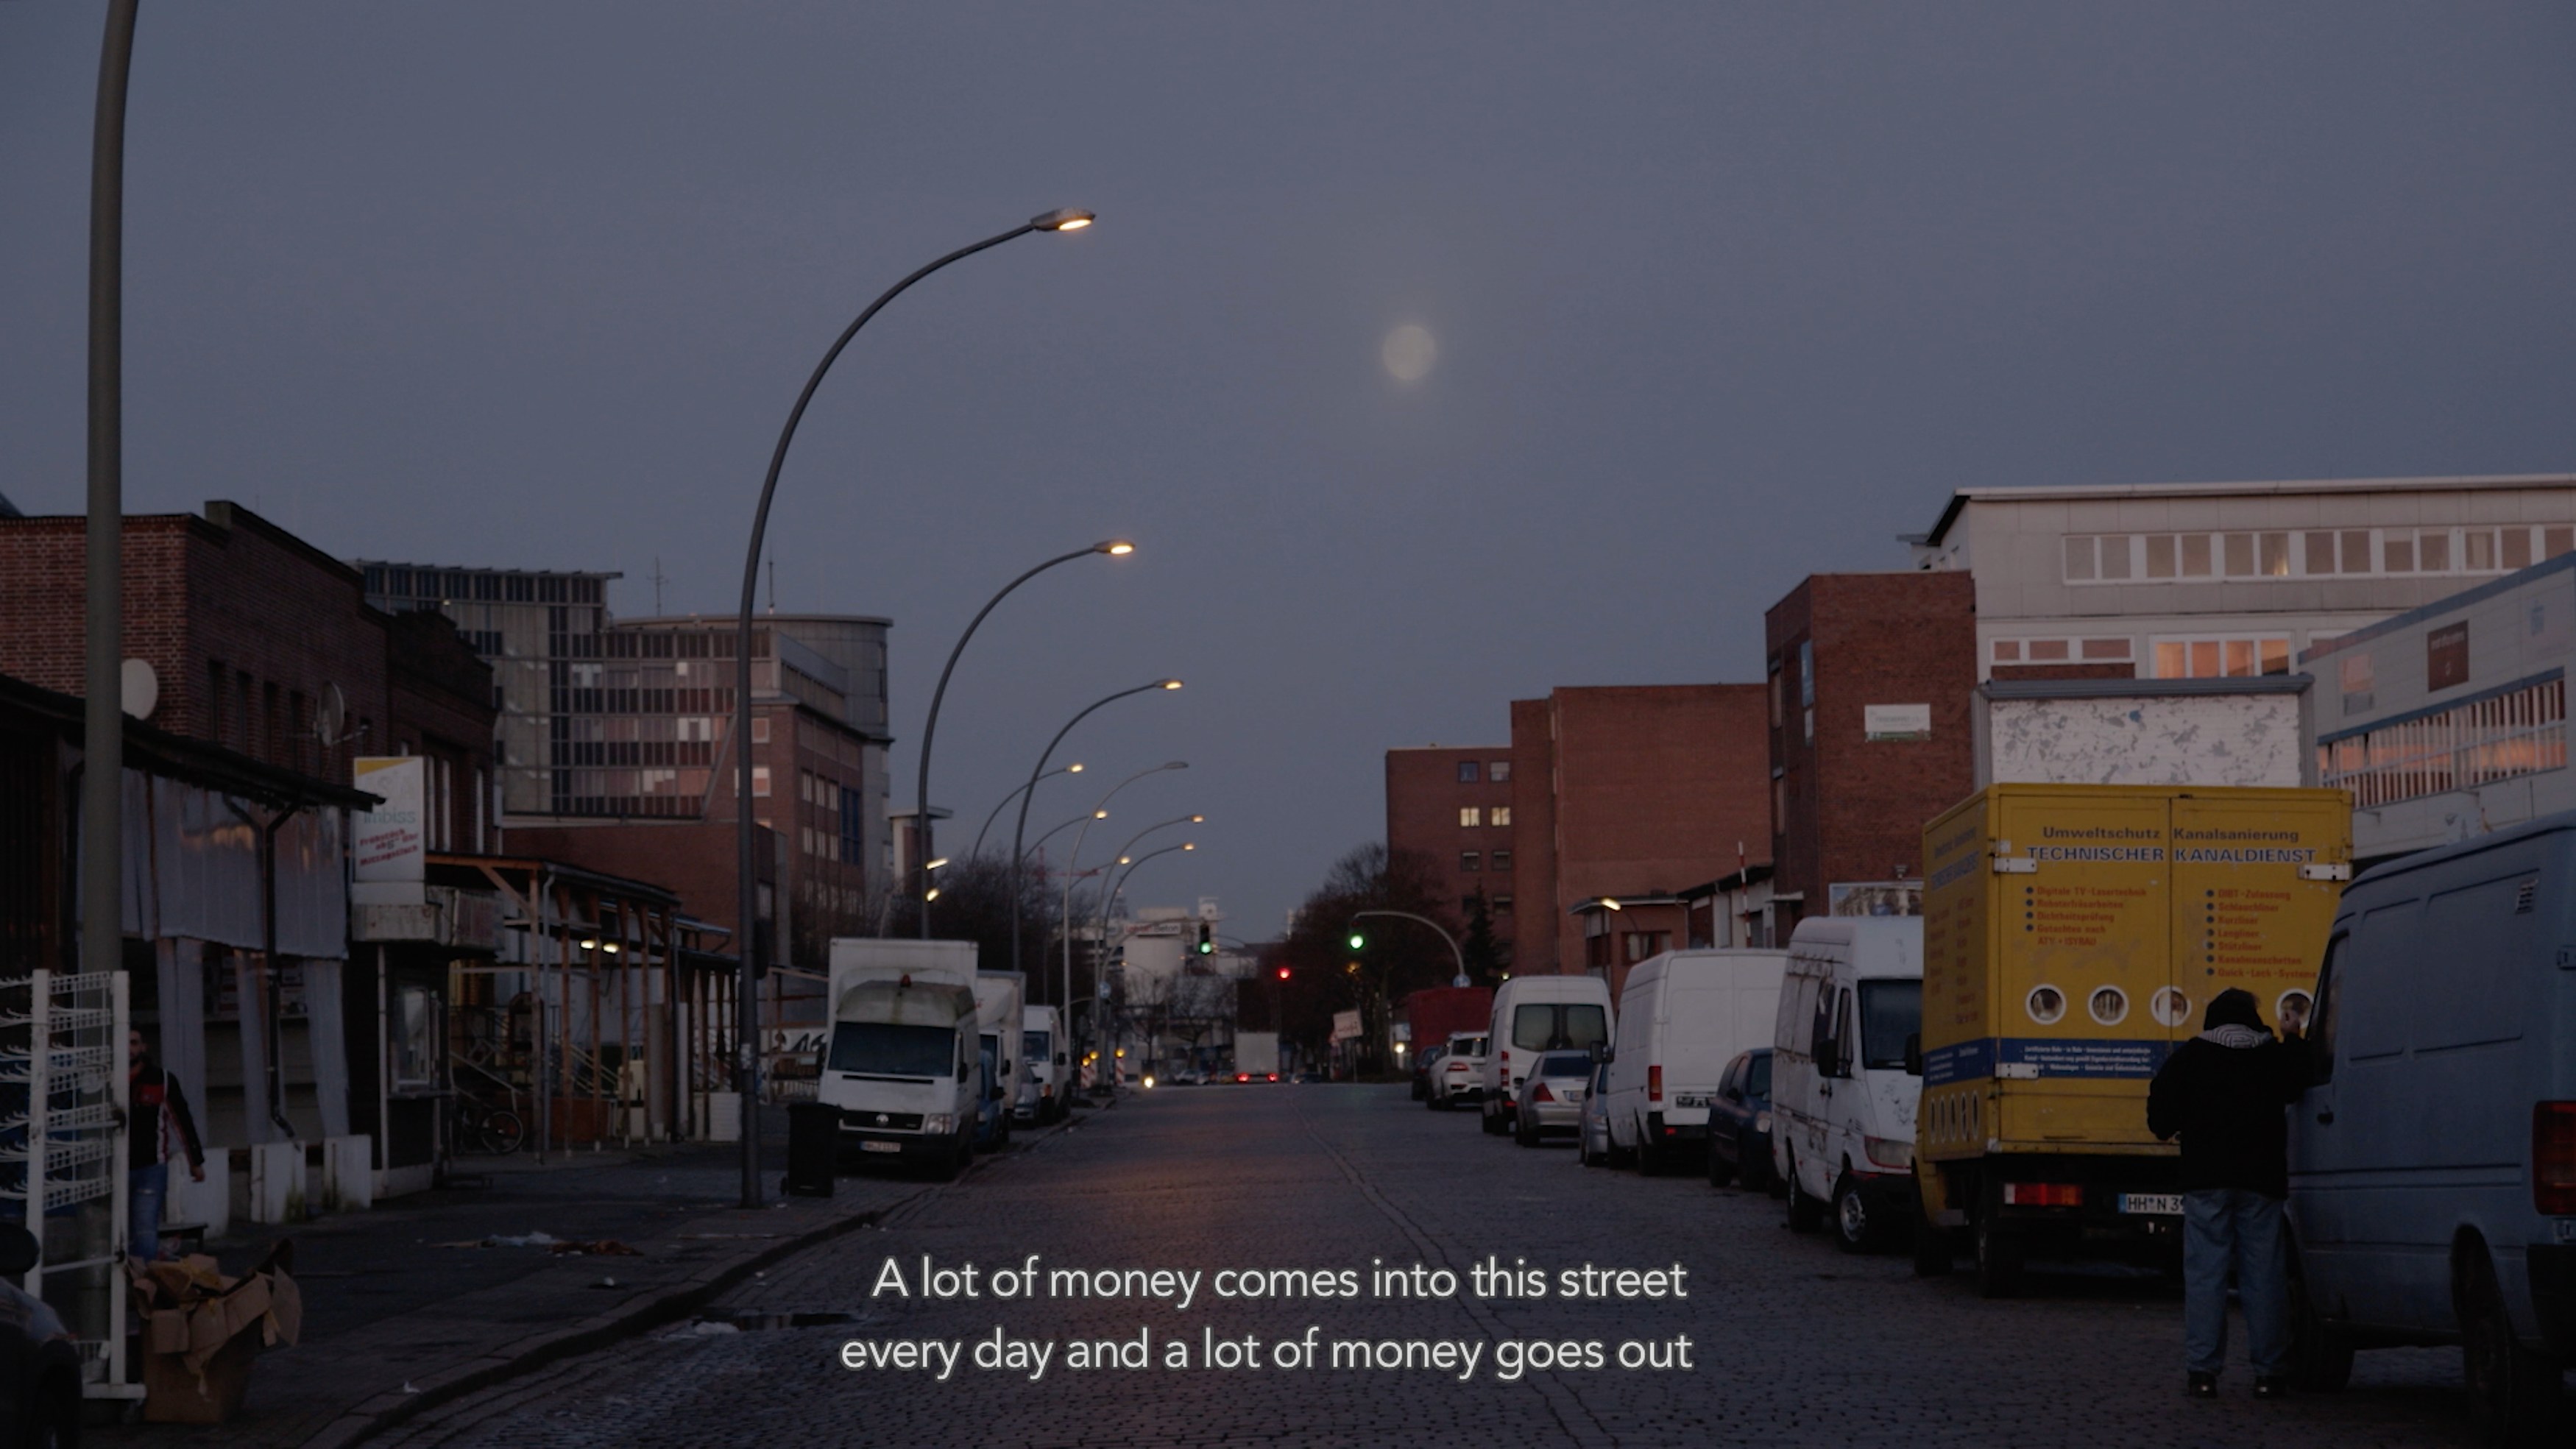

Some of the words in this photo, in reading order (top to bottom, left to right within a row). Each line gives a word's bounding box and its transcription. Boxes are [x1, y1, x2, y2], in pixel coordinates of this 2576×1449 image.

[2042, 826, 2161, 840] Umweltschutz
[2173, 827, 2299, 843] Kanalsanierung
[2026, 846, 2165, 862] TECHNISCHER
[2175, 847, 2317, 864] KANALDIENST
[2128, 1197, 2148, 1211] HH
[2157, 1197, 2166, 1211] N
